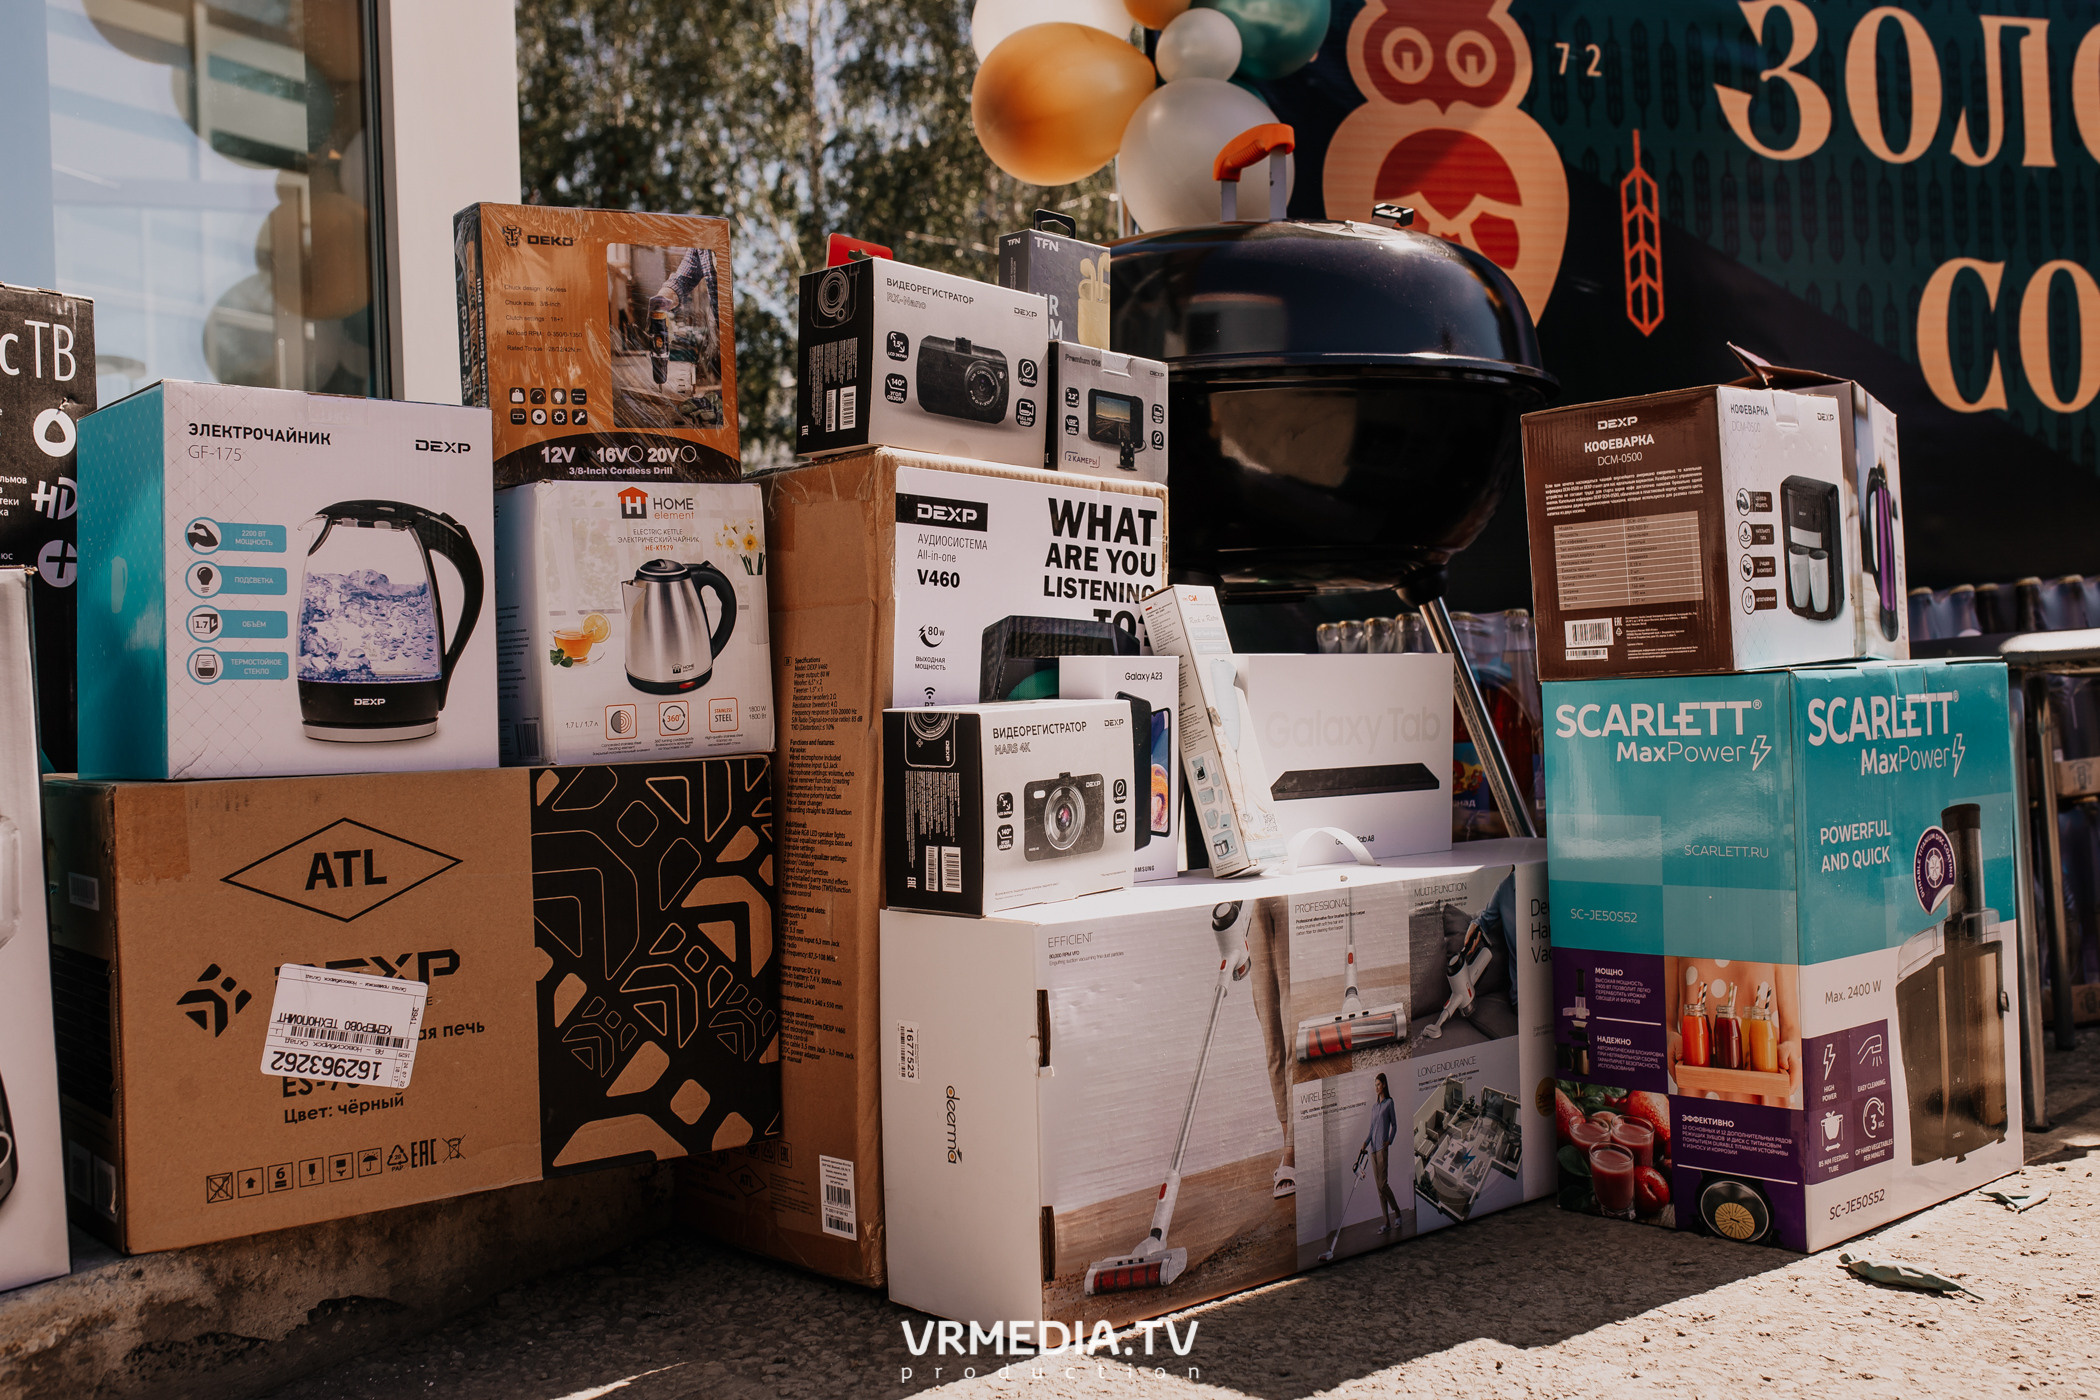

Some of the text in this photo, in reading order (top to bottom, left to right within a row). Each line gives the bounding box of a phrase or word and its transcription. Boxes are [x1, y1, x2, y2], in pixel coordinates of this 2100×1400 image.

[1714, 0, 2100, 168] ЗОЛ
[527, 235, 574, 247] DEKO
[1007, 238, 1021, 246] TFN
[1034, 236, 1059, 252] TFN
[886, 278, 974, 305] ВИДЕОРЕГИСТРАТОР
[1014, 307, 1038, 318] DEXP
[1065, 354, 1091, 365] Premium
[1731, 404, 1769, 415] КОФЕВАРКА
[1817, 413, 1834, 421] DEXP
[1597, 415, 1638, 430] DEXP
[188, 423, 331, 445] ЭЛЕКТРОЧАЙНИК
[415, 439, 471, 454] DEXP
[1584, 433, 1655, 453] КОФЕВАРКА
[188, 445, 242, 462] GF-175
[541, 446, 680, 463] 12V 16V 20V
[1068, 454, 1098, 466] 2 КАМЕРЫ
[1597, 452, 1643, 466] DCM-0500
[569, 467, 673, 475] 3/8-Inch Cordless Drill
[652, 497, 694, 511] HOME
[653, 510, 695, 520] element
[916, 503, 978, 523] DEXP
[1048, 497, 1157, 547] WHAT
[617, 535, 700, 544] ЭЛЕКТРИЧЕСКИЙ ЧАЙНИК
[633, 528, 683, 536] ELECTRIC KETTLE
[235, 538, 273, 546] МОЩНОСТЬ
[917, 533, 987, 550] АУДИОСИСТЕМА
[917, 549, 957, 563] All-in-one
[1045, 543, 1156, 577] ARE YOU
[234, 576, 274, 584] ПОДСВЕТКА
[917, 568, 960, 588] V460
[195, 620, 209, 629] 1.7
[242, 620, 266, 628] ОБЪЁМ
[231, 658, 283, 666] ТЕРМОСТОЙКОЕ
[915, 656, 945, 664] ВЫХОДНАЯ
[915, 663, 946, 671] МОЩНОСТЬ
[1124, 672, 1163, 682] Galaxy A23
[353, 697, 387, 706] DEXP
[714, 714, 732, 722] STEEL
[1104, 719, 1124, 727] DEXP
[1555, 700, 1751, 738] SCARLETT
[1808, 691, 1954, 747] SCARLETT
[992, 722, 1087, 740] ВИДЕОРЕГИСТРАТОР
[1265, 706, 1441, 753] Galaxy Tab
[994, 742, 1031, 755] MARS 4K
[1616, 741, 1746, 763] MaxPower
[1860, 744, 1951, 777] MaxPower
[1819, 820, 1892, 845] POWERFUL
[1684, 844, 1770, 859] SCARLETT.RU
[1821, 846, 1891, 873] AND QUICK
[304, 849, 388, 891] ATL
[1134, 865, 1155, 873] AMSUNG
[1414, 882, 1467, 897] MULTI-FUNCTION
[1295, 898, 1351, 913] PROFESSIONAL
[1570, 908, 1638, 924] SC-JE50S52
[1047, 932, 1093, 948] EFFICIENT
[274, 948, 461, 986] XP
[1595, 967, 1623, 976] МОЩНО
[1824, 979, 1882, 1005] Max. 2400 W
[277, 1012, 392, 1036] КЕМЕРОВО ТЕХНОПОИНТ
[443, 1018, 485, 1039] печь
[285, 1037, 308, 1047] Склад
[313, 1040, 362, 1053] Новосибирск
[1597, 1035, 1632, 1046] НАДЕЖНО
[906, 1027, 914, 1079] 1677523
[270, 1050, 382, 1081] 162963262
[1417, 1056, 1477, 1077] LONG ENDURANCE
[1823, 1084, 1835, 1093] HIGH
[1857, 1078, 1886, 1093] EASY CLEANING
[1301, 1088, 1336, 1104] WIRELESS
[1822, 1093, 1837, 1102] POWER
[284, 1092, 405, 1124] Цвет: чёрный
[945, 1085, 961, 1164] deerma
[1682, 1114, 1735, 1128] ЭФФЕКТИВНО
[1870, 1113, 1878, 1130] 3
[1727, 1130, 1774, 1142] ДОПОЛНИТЕЛЬНЫХ
[1750, 1139, 1782, 1149] ТИТАНОВЫМ
[1855, 1139, 1893, 1156] OF HARD VEGETABLES
[411, 1138, 437, 1168] EAC
[1831, 1153, 1849, 1164] FEEDING
[1863, 1150, 1885, 1162] PER MINUTE
[1828, 1165, 1839, 1173] TUBE
[1829, 1187, 1886, 1221] SC-JE50S52
